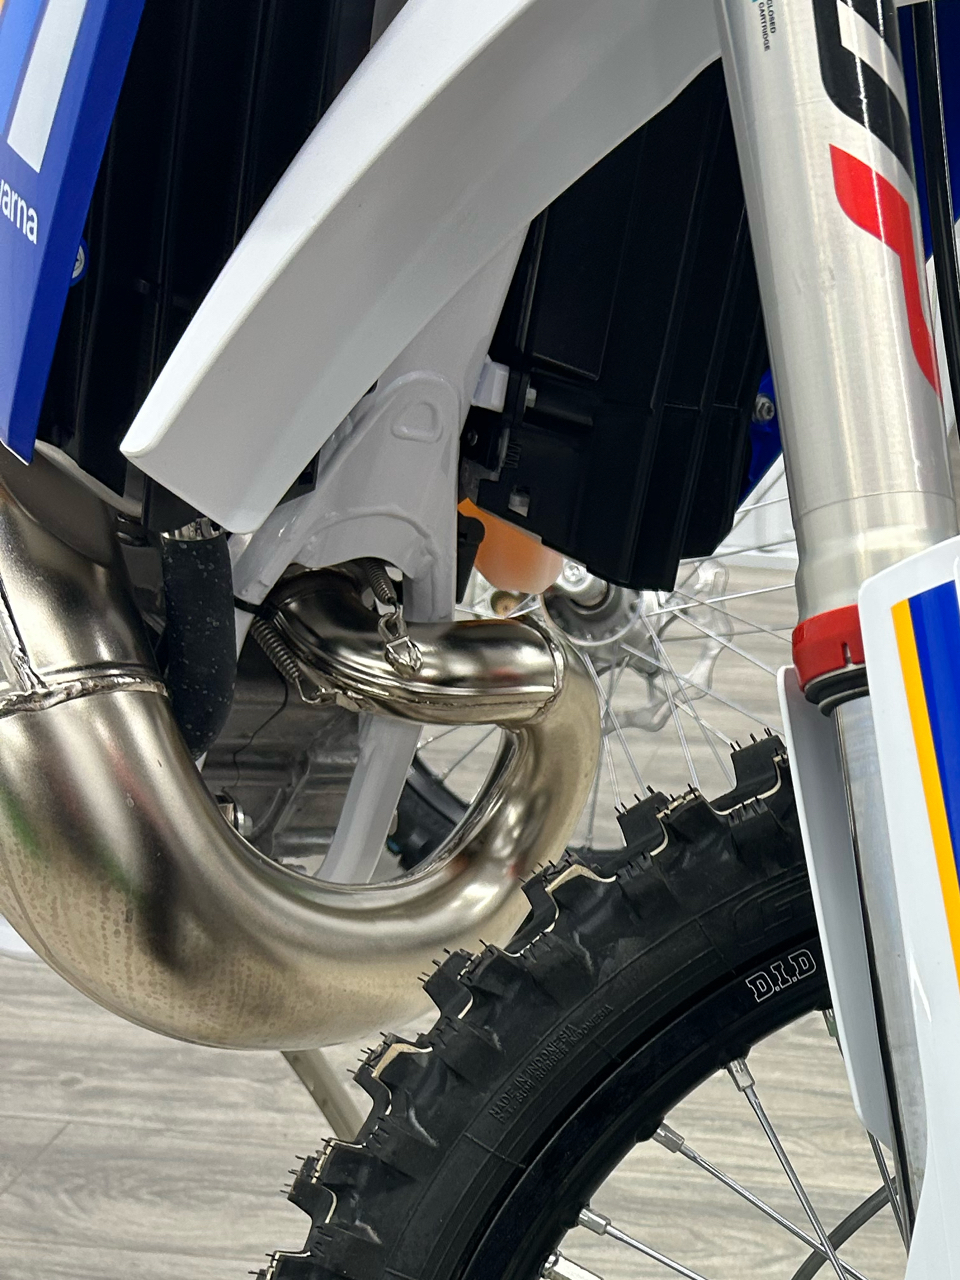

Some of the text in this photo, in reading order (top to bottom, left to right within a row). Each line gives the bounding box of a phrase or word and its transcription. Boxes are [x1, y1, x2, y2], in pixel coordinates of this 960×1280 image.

[758, 1, 771, 52] CARTRIDGE
[488, 1086, 518, 1117] MADE
[525, 1022, 578, 1077] INDONESIA
